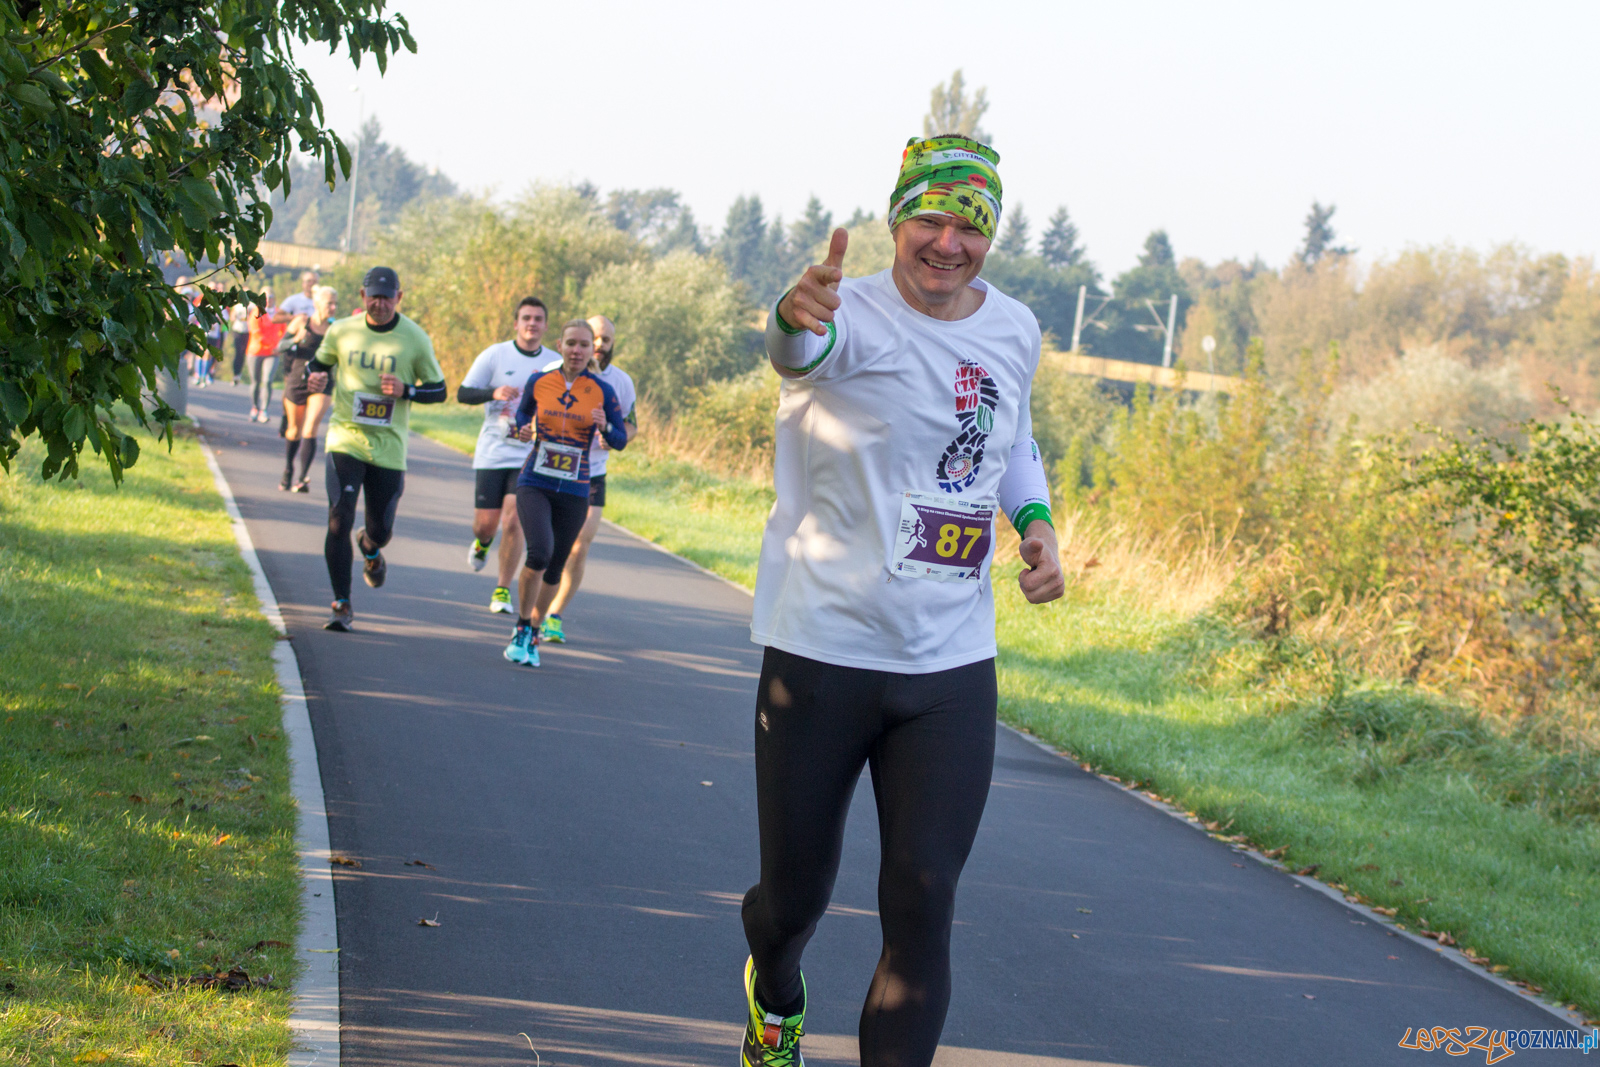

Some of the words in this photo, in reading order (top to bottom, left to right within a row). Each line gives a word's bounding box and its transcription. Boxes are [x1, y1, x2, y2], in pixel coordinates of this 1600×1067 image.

[348, 350, 396, 372] run
[366, 403, 387, 418] 80
[551, 454, 572, 470] 12
[936, 523, 983, 560] 87
